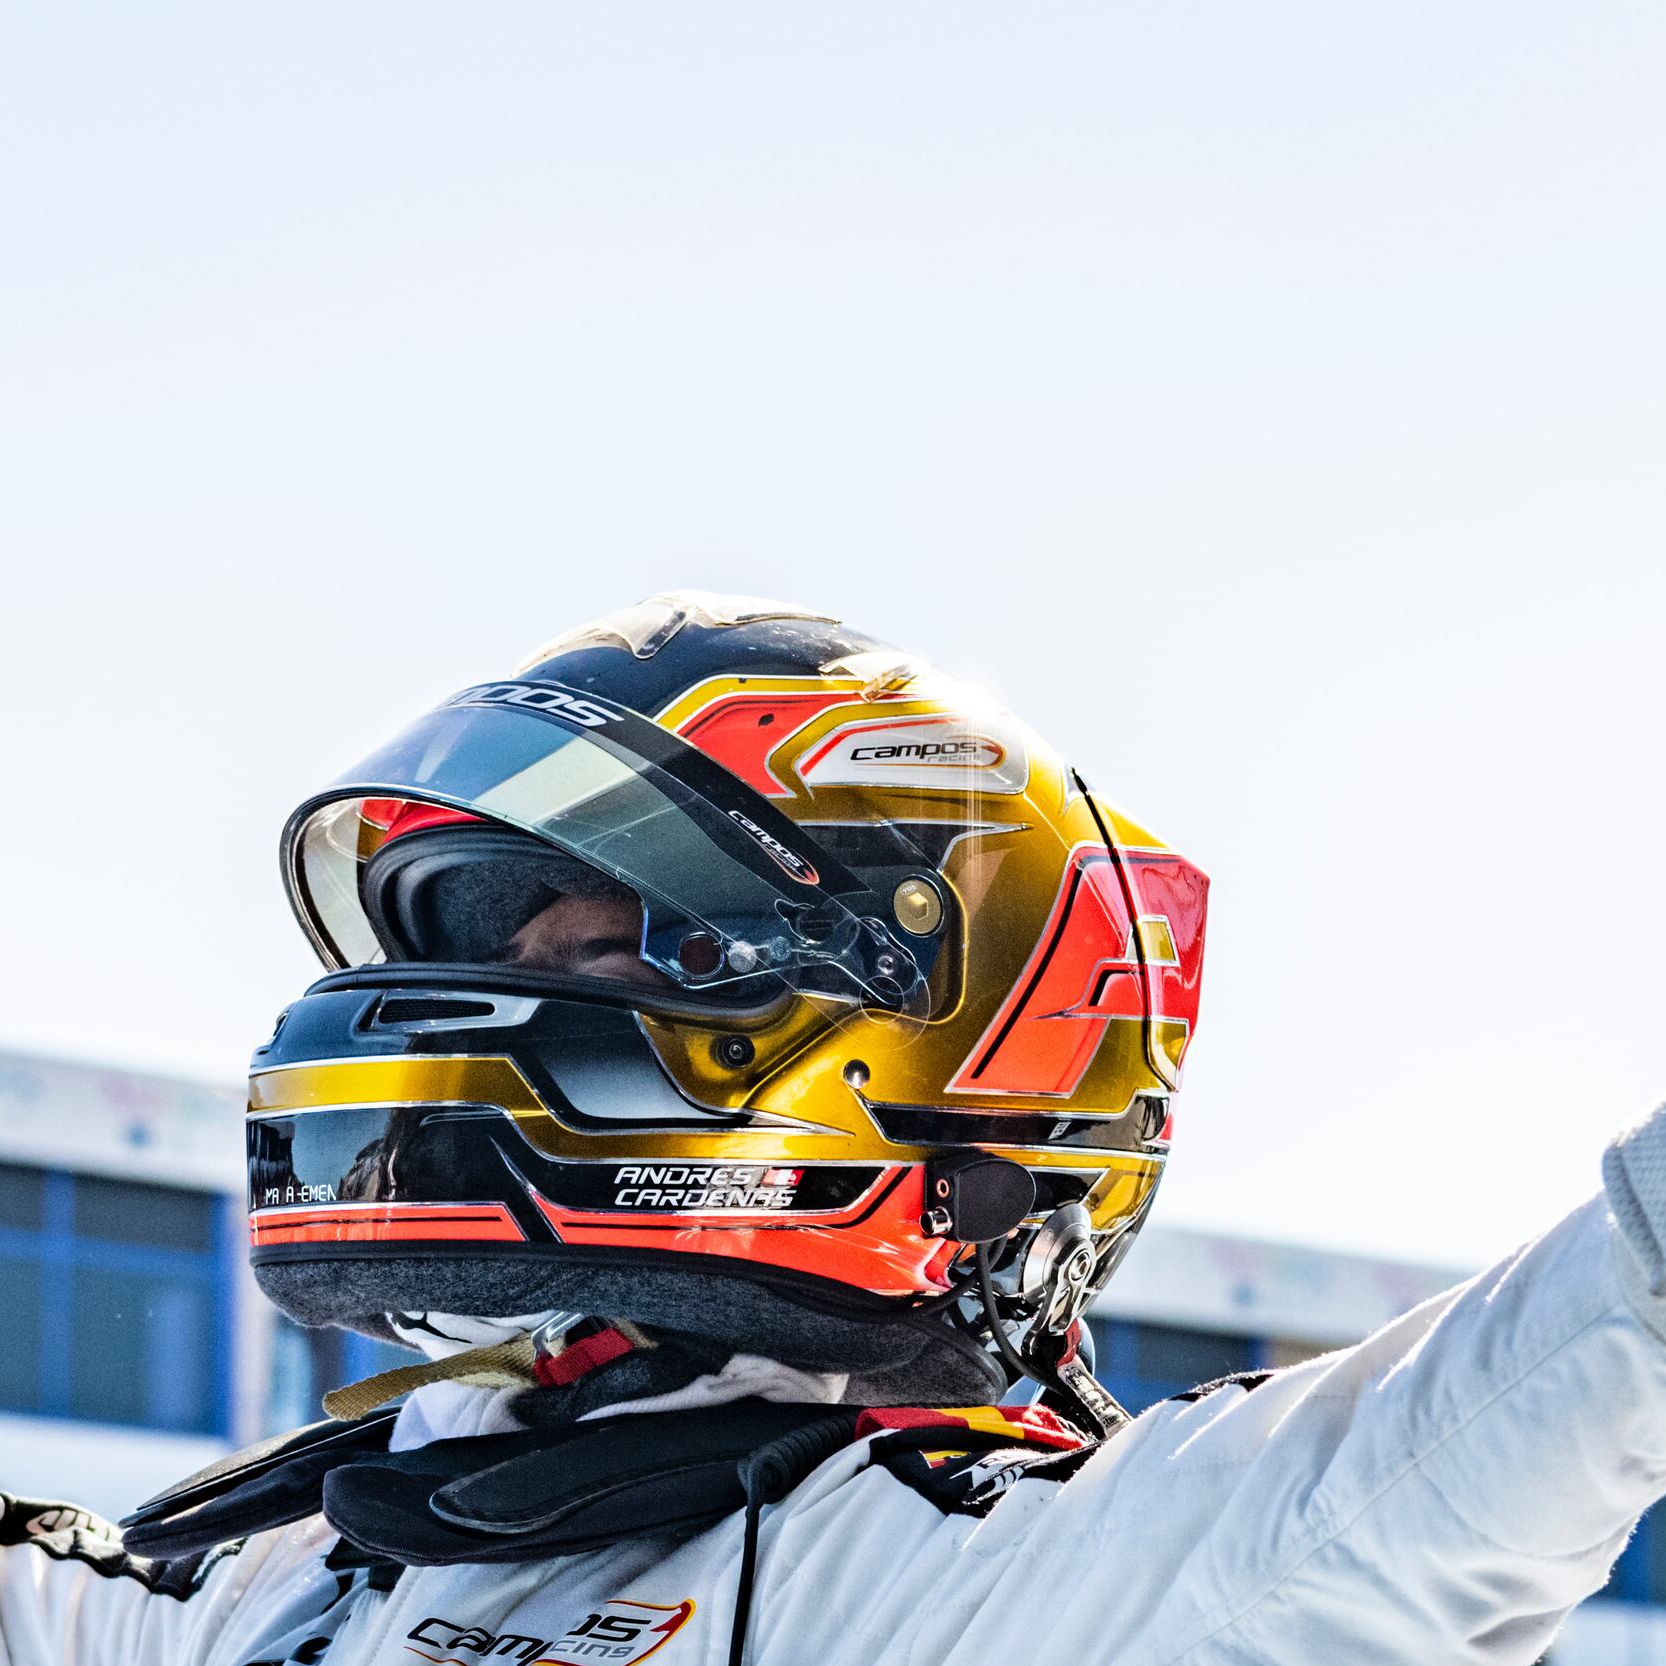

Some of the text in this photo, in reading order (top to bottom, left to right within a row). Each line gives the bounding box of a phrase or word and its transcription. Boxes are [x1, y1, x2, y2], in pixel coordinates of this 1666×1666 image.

[850, 741, 977, 762] campos
[728, 810, 804, 868] campos
[613, 1166, 755, 1185] ANDRES
[614, 1187, 798, 1208] CARDENAS
[549, 1639, 636, 1659] cing
